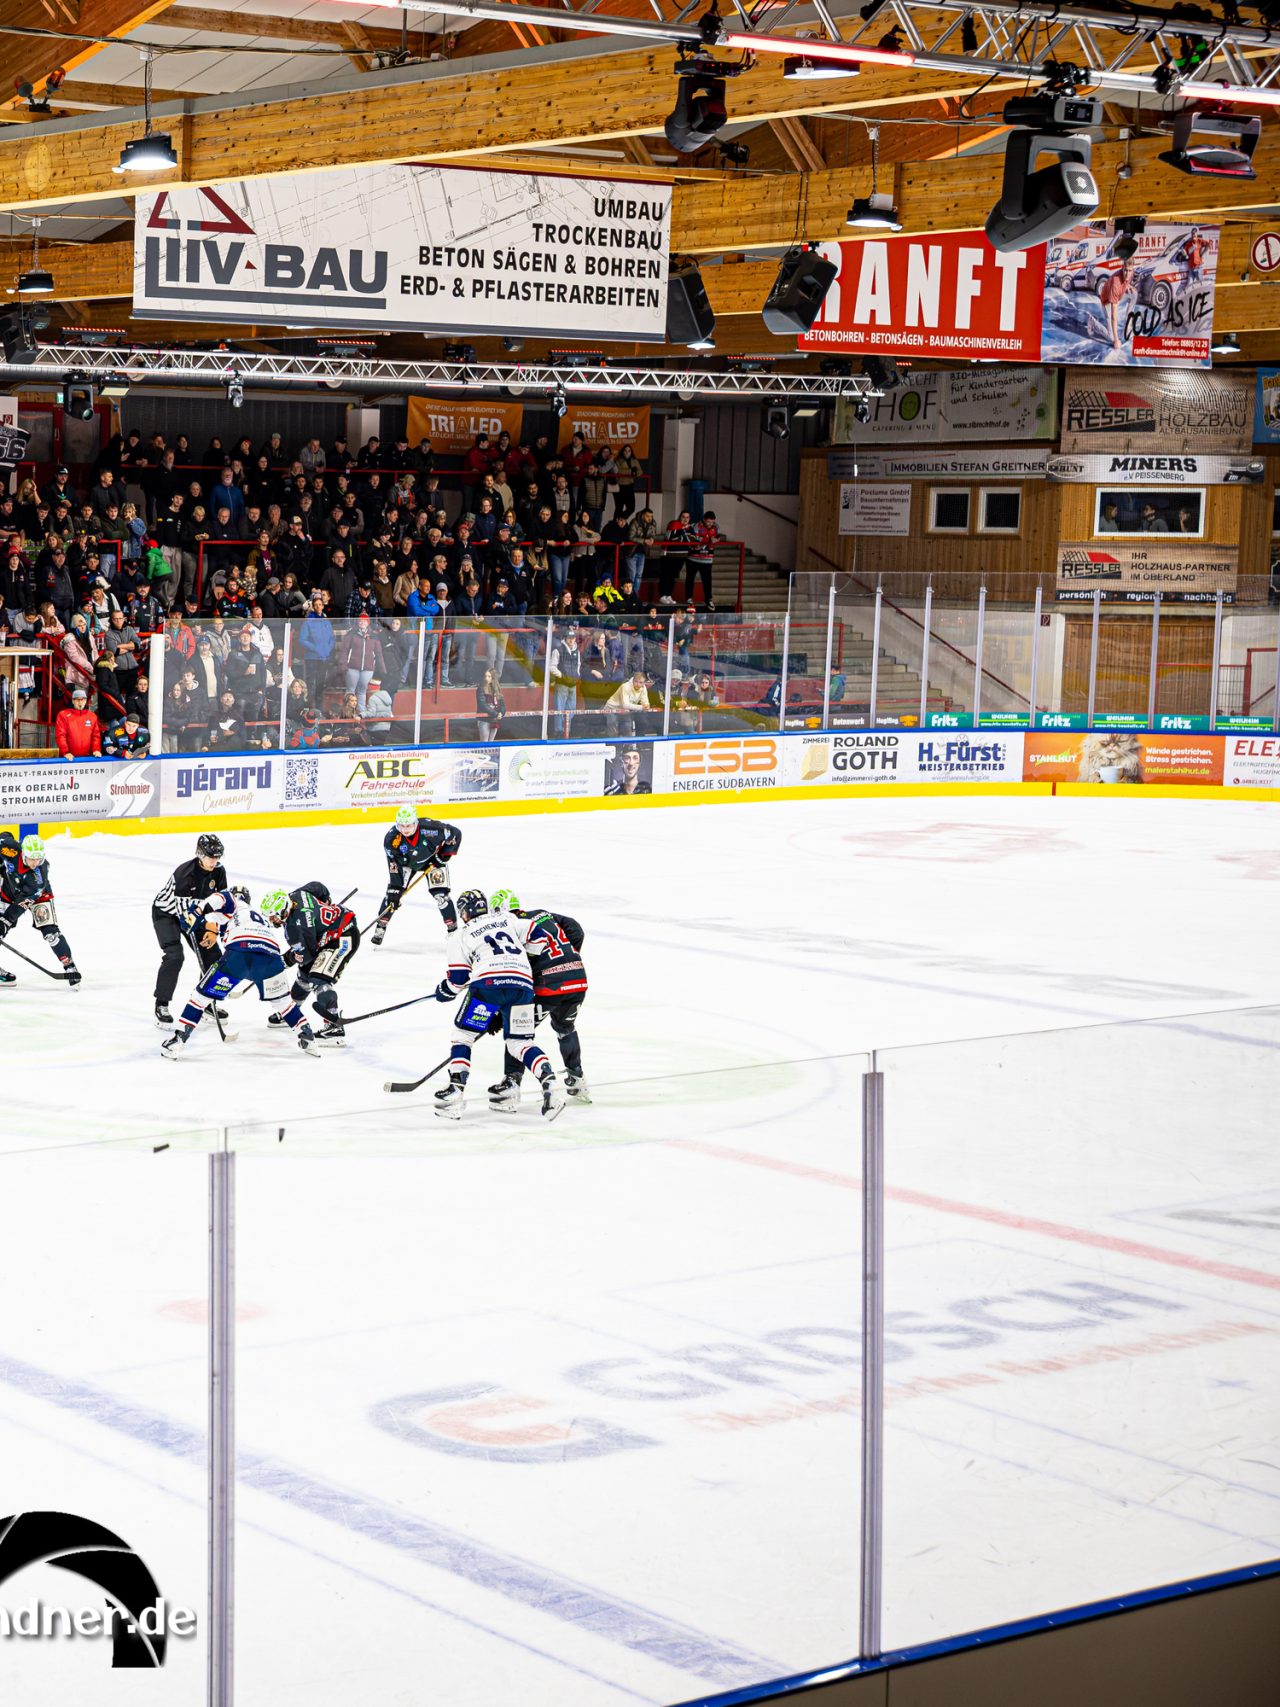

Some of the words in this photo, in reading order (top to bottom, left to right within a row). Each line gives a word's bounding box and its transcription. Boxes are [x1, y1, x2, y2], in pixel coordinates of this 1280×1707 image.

[594, 197, 664, 221] UMBAU
[532, 223, 662, 251] TROCKENBAU
[1138, 236, 1167, 248] RANFT
[419, 246, 485, 269] BETON
[492, 246, 556, 275] SÄGEN
[559, 255, 578, 275] &
[584, 256, 661, 280] BOHREN
[400, 274, 446, 297] ERD-
[451, 276, 466, 299] &
[471, 279, 660, 308] PFLASTERARBEITEN
[1124, 304, 1162, 341] COLD
[1163, 300, 1184, 327] AS
[1189, 291, 1214, 324] ICE
[804, 330, 865, 344] BETONBOHREN
[870, 332, 924, 347] BETONSÄGEN
[929, 335, 1023, 351] BAUMASCHINENVERLEIH
[969, 376, 1029, 391] Kindergärten
[950, 395, 968, 404] und
[972, 391, 1008, 402] Schulen
[1068, 409, 1154, 431] RESSLER
[1159, 413, 1247, 428] HOLZBAU
[1159, 427, 1245, 436] ALTBAUSANIERUNG
[890, 461, 948, 472] IMMOBILIEN
[950, 461, 989, 472] STEFAN
[993, 460, 1045, 471] GREITNER
[1109, 457, 1197, 473] MINERS
[1135, 472, 1185, 481] PEISSENBERG
[1062, 563, 1121, 578] RESSLER
[1131, 563, 1231, 572] HOLZHAUS-PARTNER
[1143, 573, 1196, 581] OBERLAND
[931, 714, 958, 727] Fritz
[1042, 714, 1071, 727] Fritz
[1161, 716, 1192, 729] Fritz
[833, 736, 899, 748] ROLAND
[348, 752, 429, 760] Qualitäts-Ausbildung
[674, 740, 777, 775] ESB
[919, 742, 940, 762] H.
[946, 741, 1001, 762] Fürst
[1029, 753, 1077, 763] STAHLHUT
[1145, 747, 1170, 756] Wände
[1171, 747, 1213, 757] gestrichen.
[832, 752, 897, 771] GOTH
[919, 763, 1005, 771] MEISTERBETRIEB
[1145, 756, 1170, 764] Stress
[1171, 757, 1213, 766] gestrichen.
[345, 759, 426, 788] ABC
[1145, 767, 1210, 776] malerstahlhut.de
[176, 761, 272, 797] gérard
[360, 780, 426, 790] Fahrschule
[673, 779, 714, 791] ENERGIE
[718, 775, 776, 789] SÜDBAYERN
[25, 782, 80, 793] OBERLAND
[110, 783, 150, 796] Strohmaier
[2, 794, 68, 806] STROHMAIER
[72, 792, 101, 802] GMBH
[484, 931, 522, 956] 13
